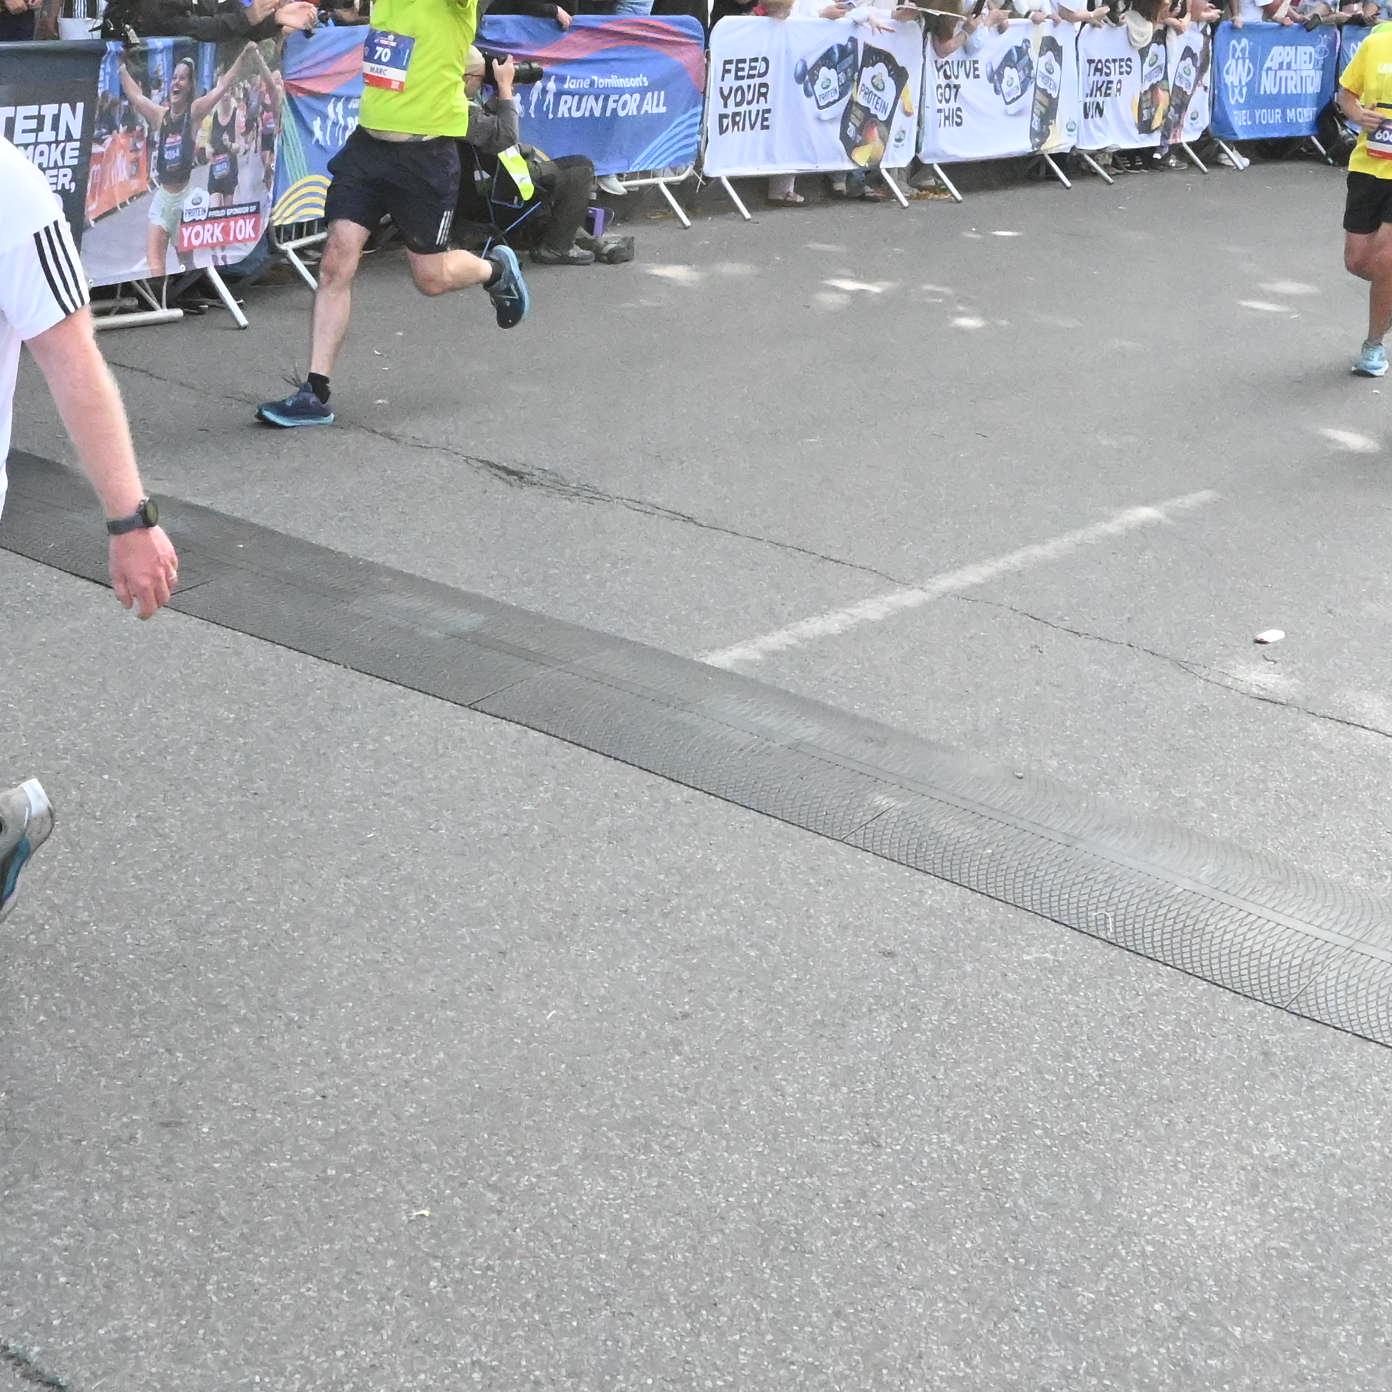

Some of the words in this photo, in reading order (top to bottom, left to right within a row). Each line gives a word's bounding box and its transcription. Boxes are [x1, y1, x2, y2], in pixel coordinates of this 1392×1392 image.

[374, 46, 391, 62] 70
[721, 57, 770, 82] FEED
[934, 59, 981, 80] YOU'VE
[1086, 56, 1133, 77] TASTES
[564, 75, 590, 88] Jane
[592, 74, 648, 88] Tomlinson's
[558, 94, 604, 118] RUN
[606, 93, 641, 117] FOR
[641, 90, 667, 114] ALL
[719, 83, 769, 109] YOUR
[936, 83, 961, 104] GOT
[718, 109, 771, 136] DRIVE
[936, 106, 964, 128] THIS
[1255, 108, 1282, 124] YOUR
[182, 222, 223, 248] YORK
[229, 218, 255, 241] 10K
